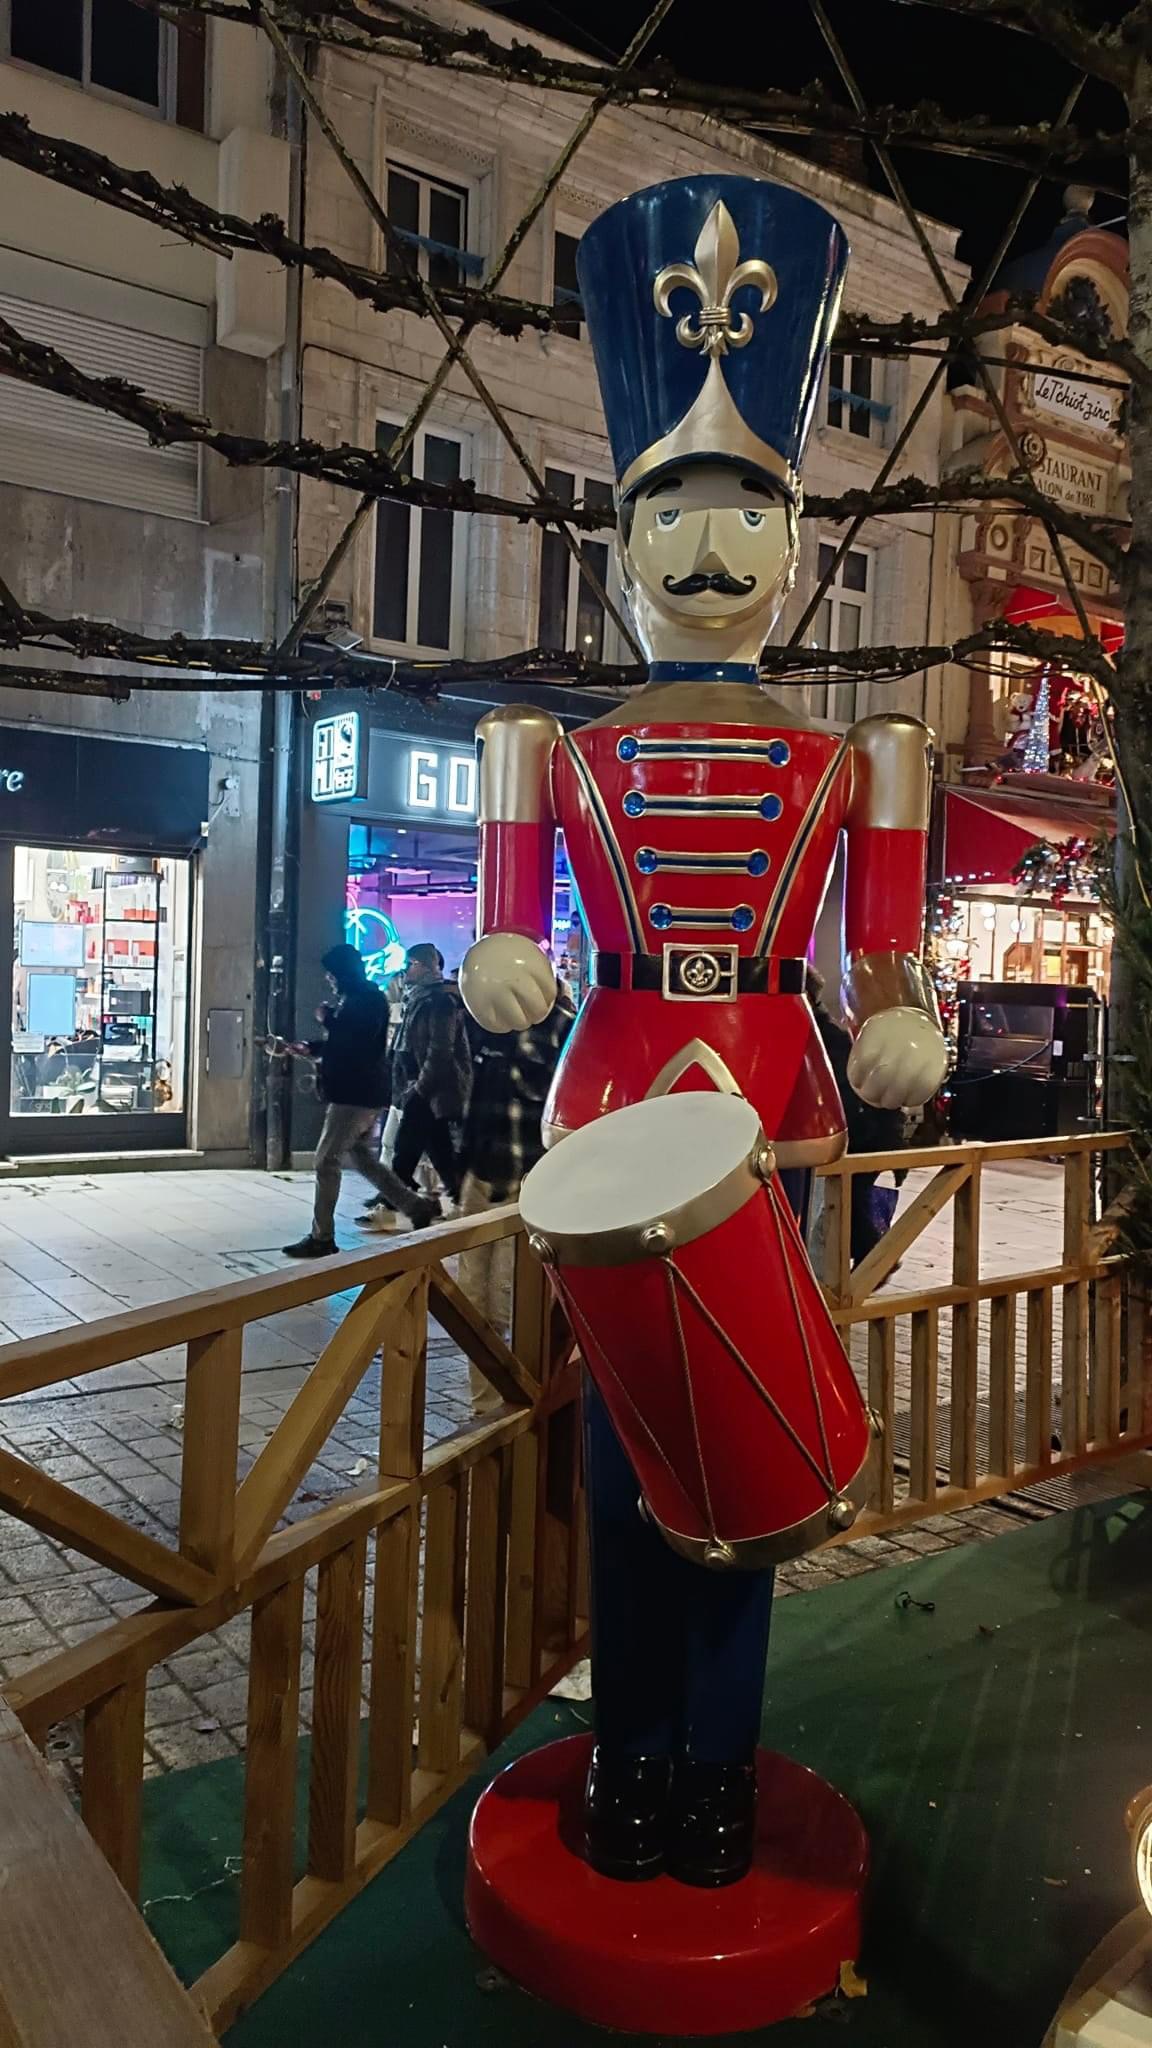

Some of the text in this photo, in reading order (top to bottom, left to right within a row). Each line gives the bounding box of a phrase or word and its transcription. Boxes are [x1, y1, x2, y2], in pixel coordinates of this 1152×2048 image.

[1035, 376, 1049, 400] Le
[1083, 400, 1111, 422] zinc
[1037, 478, 1064, 497] ALON
[1038, 457, 1103, 492] STAURANT
